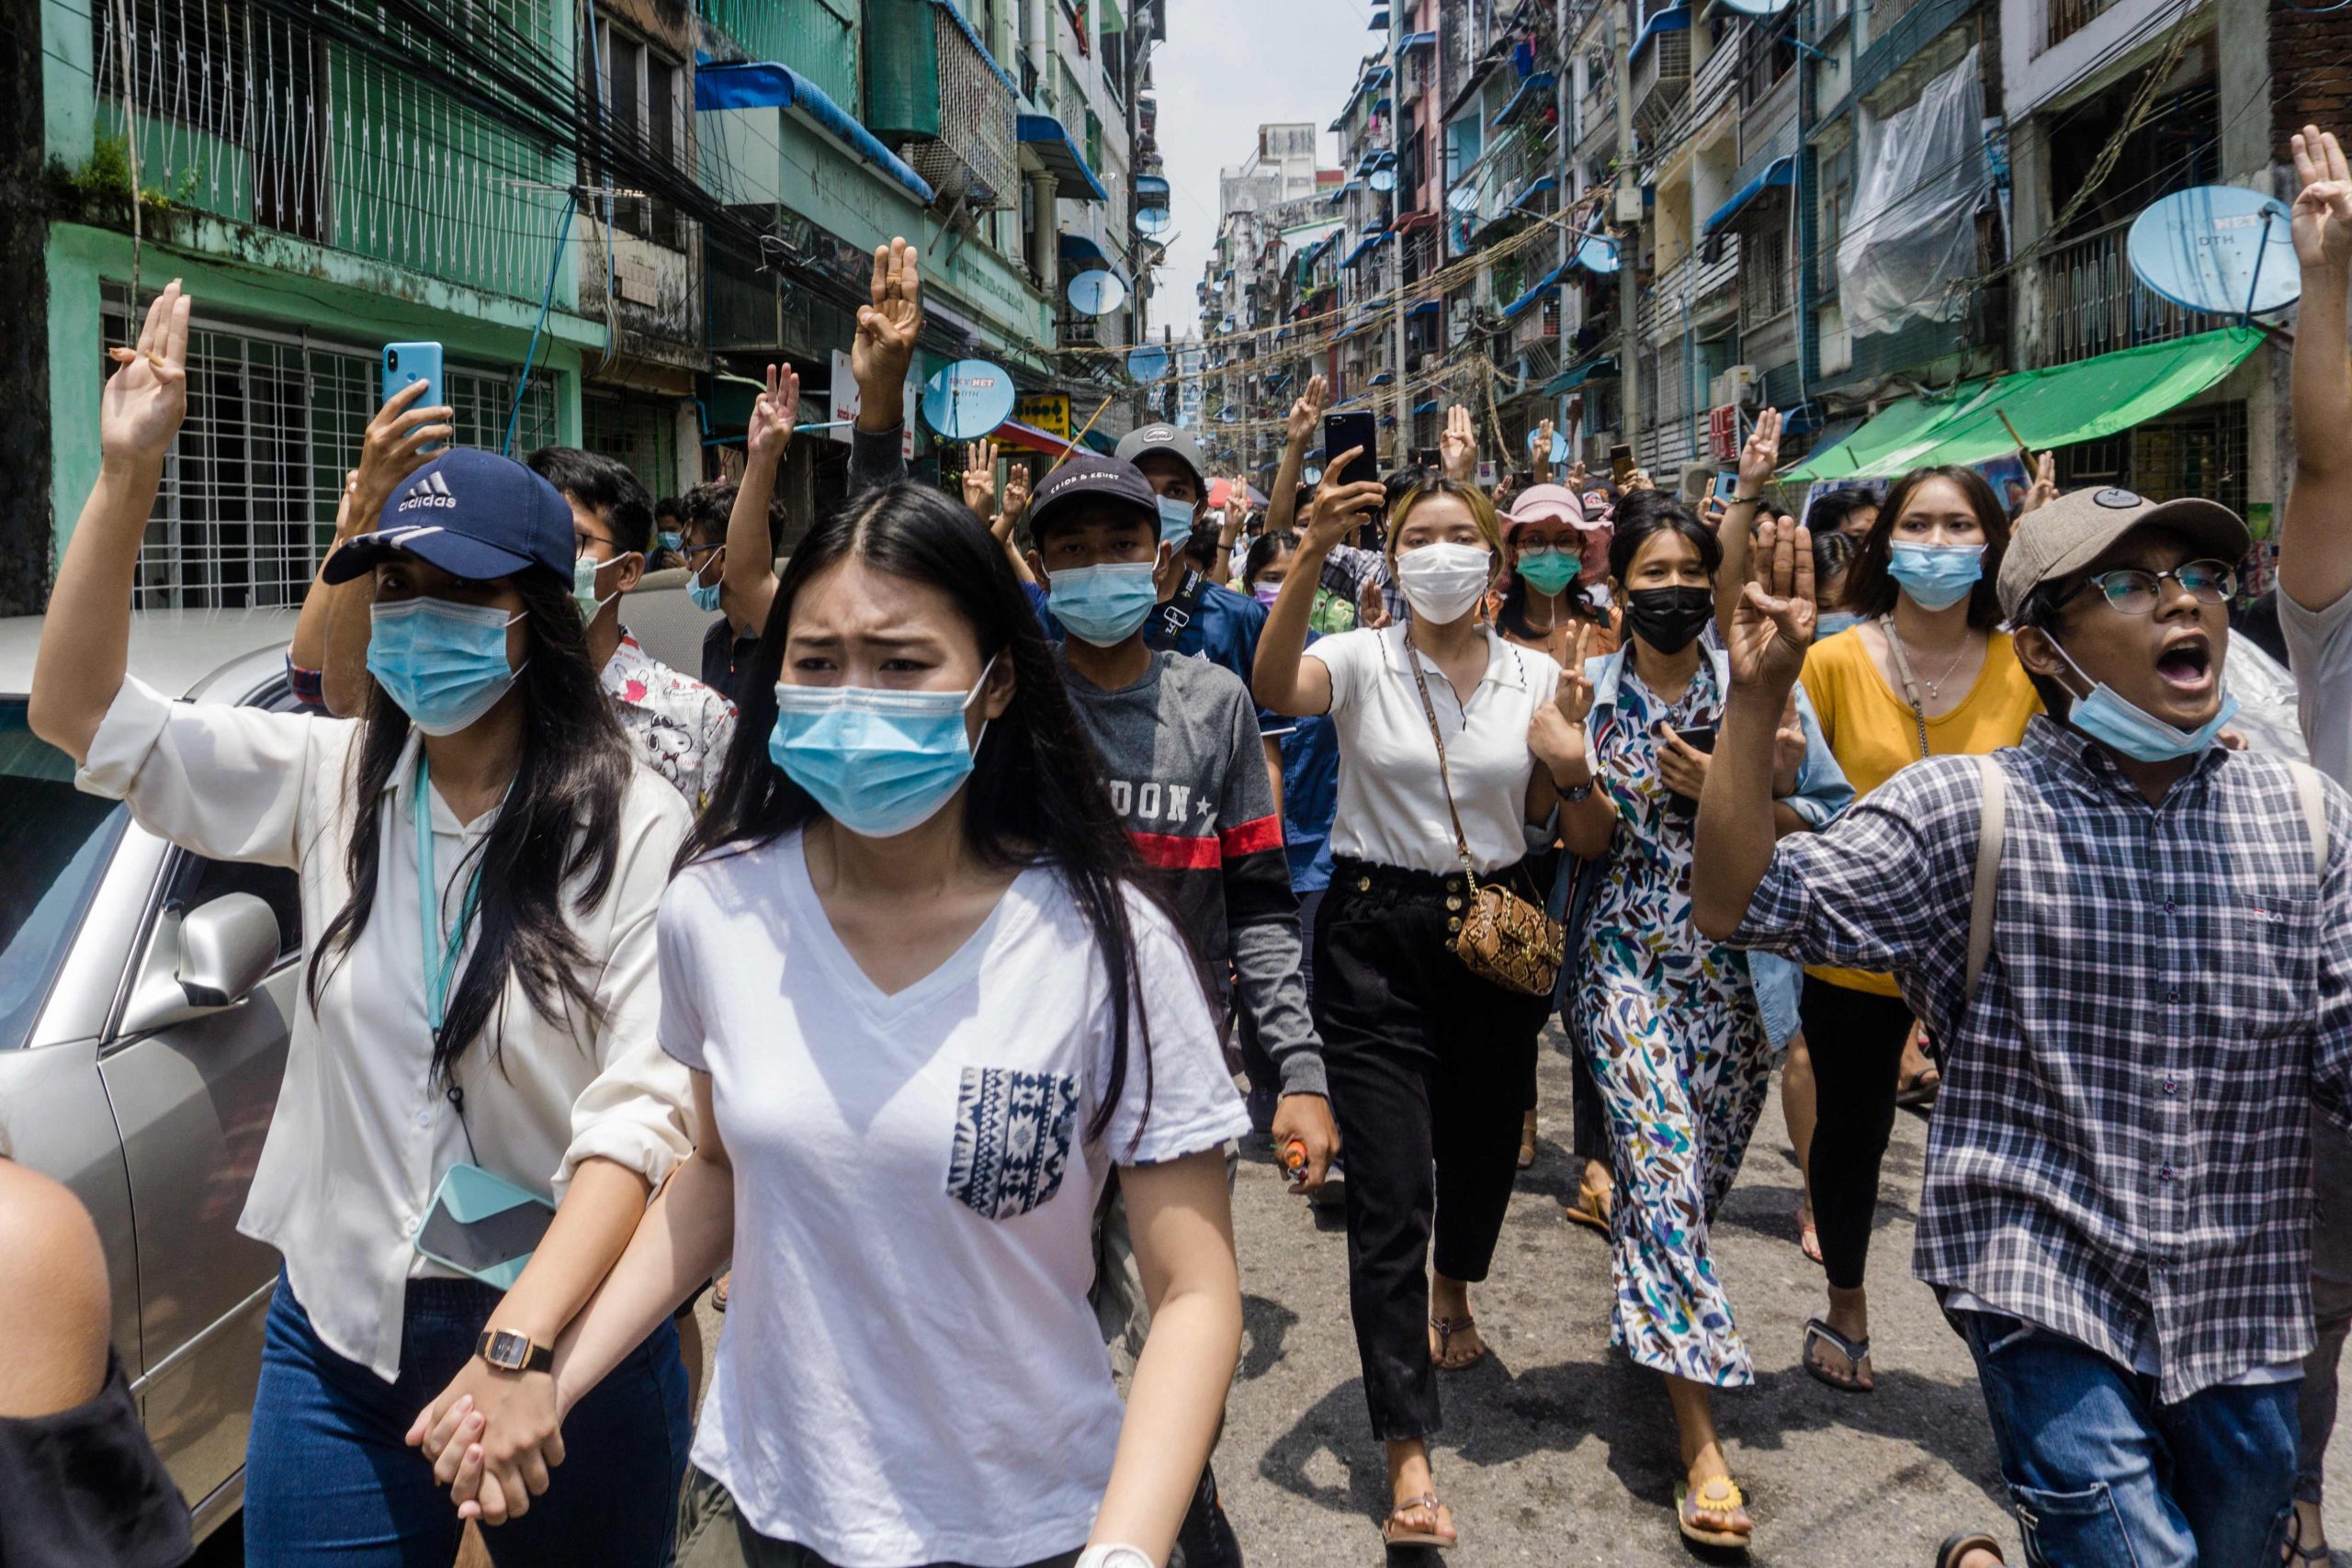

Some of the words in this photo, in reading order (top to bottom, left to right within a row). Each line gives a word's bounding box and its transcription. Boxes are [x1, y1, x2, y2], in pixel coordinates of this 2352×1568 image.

[2199, 235, 2234, 246] DTH
[398, 494, 457, 513] adidas
[1097, 779, 1191, 822] DON
